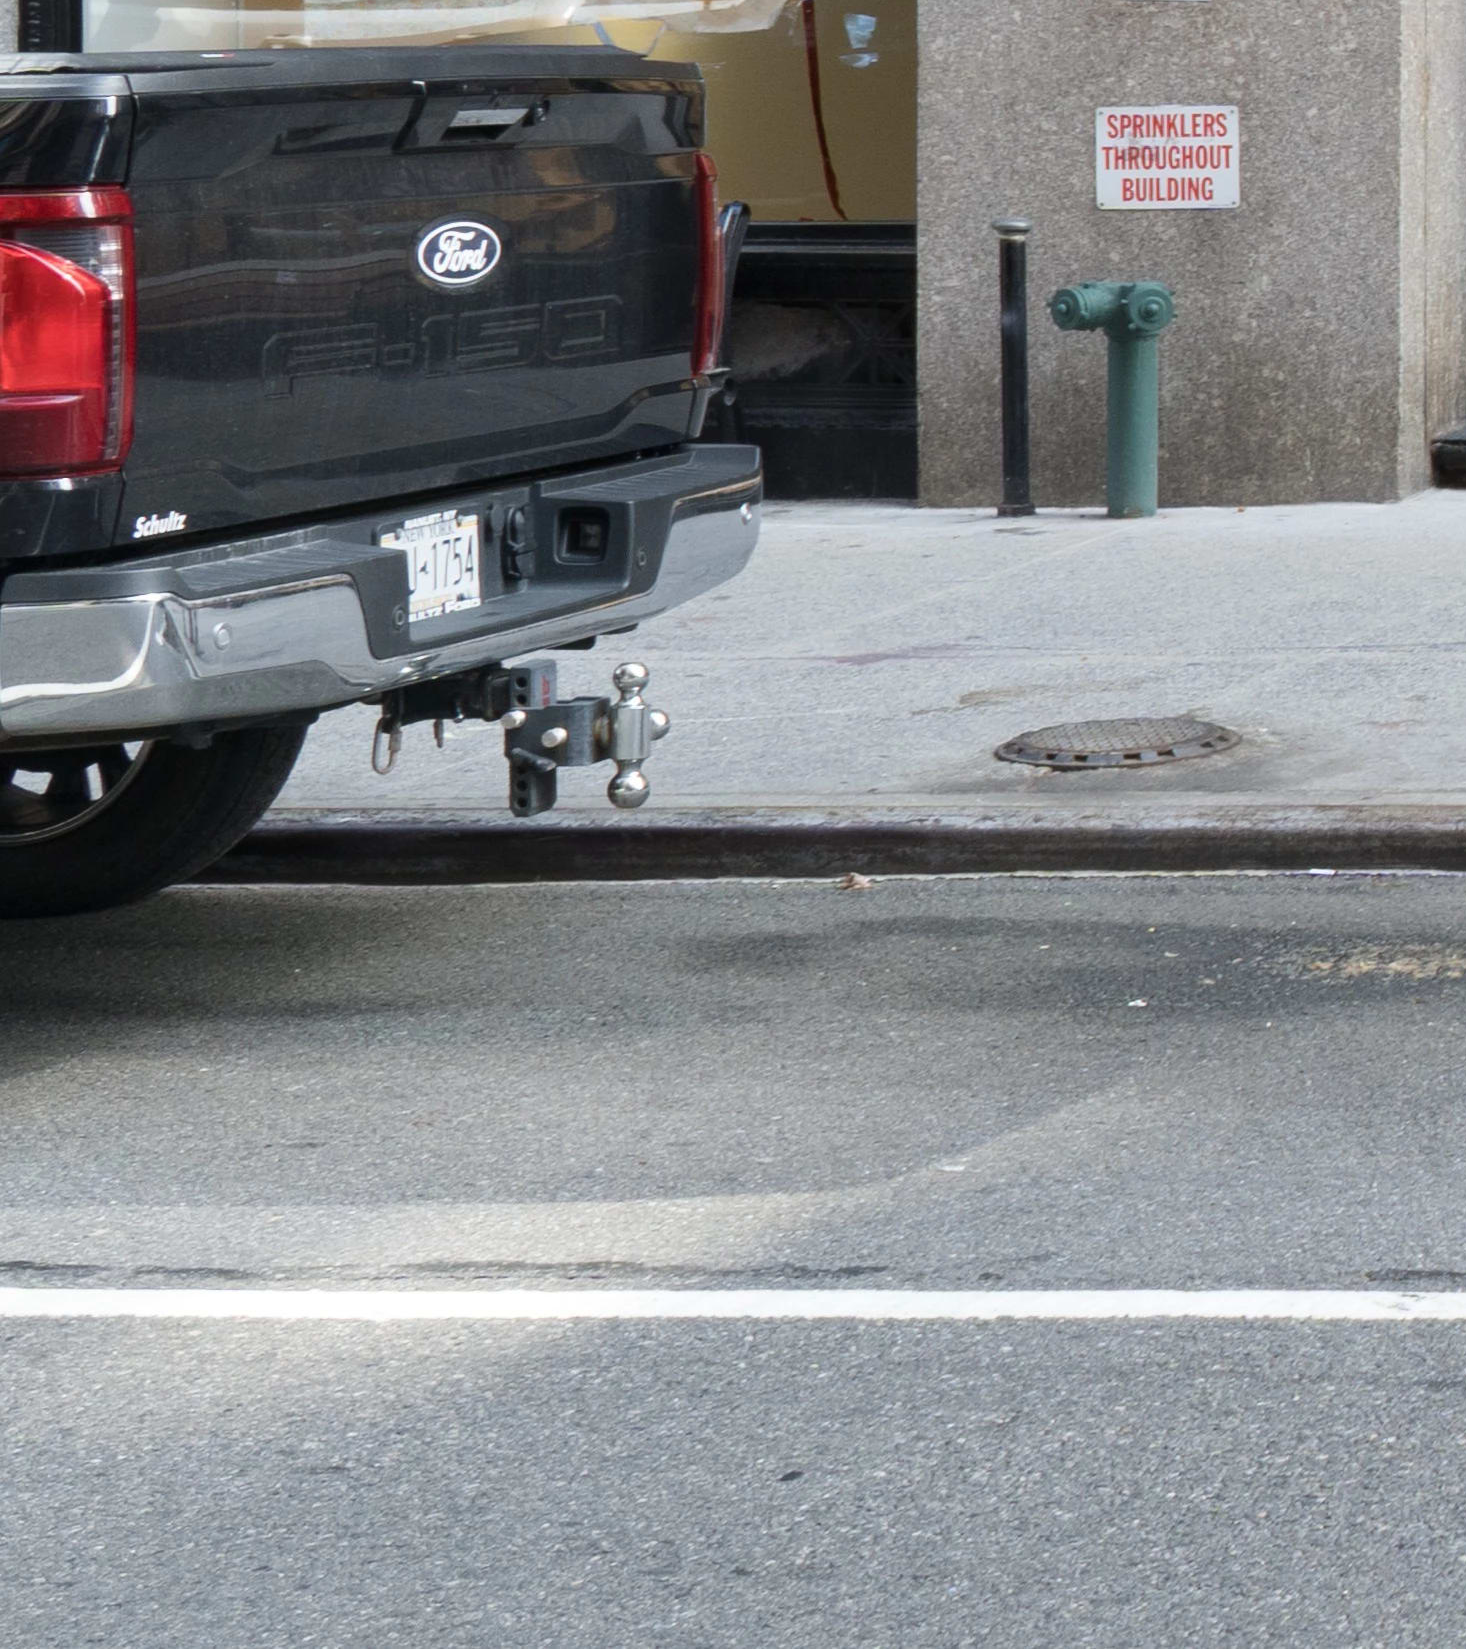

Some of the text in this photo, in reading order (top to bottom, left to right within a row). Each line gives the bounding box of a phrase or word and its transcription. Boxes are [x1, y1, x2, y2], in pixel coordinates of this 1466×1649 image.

[1107, 113, 1228, 138] SPRINKLERS
[1102, 145, 1233, 170] THROUGHOUT
[1122, 177, 1214, 202] BUILDING
[433, 230, 488, 274] Ford
[262, 294, 624, 399] F-150
[133, 510, 187, 538] Schultz
